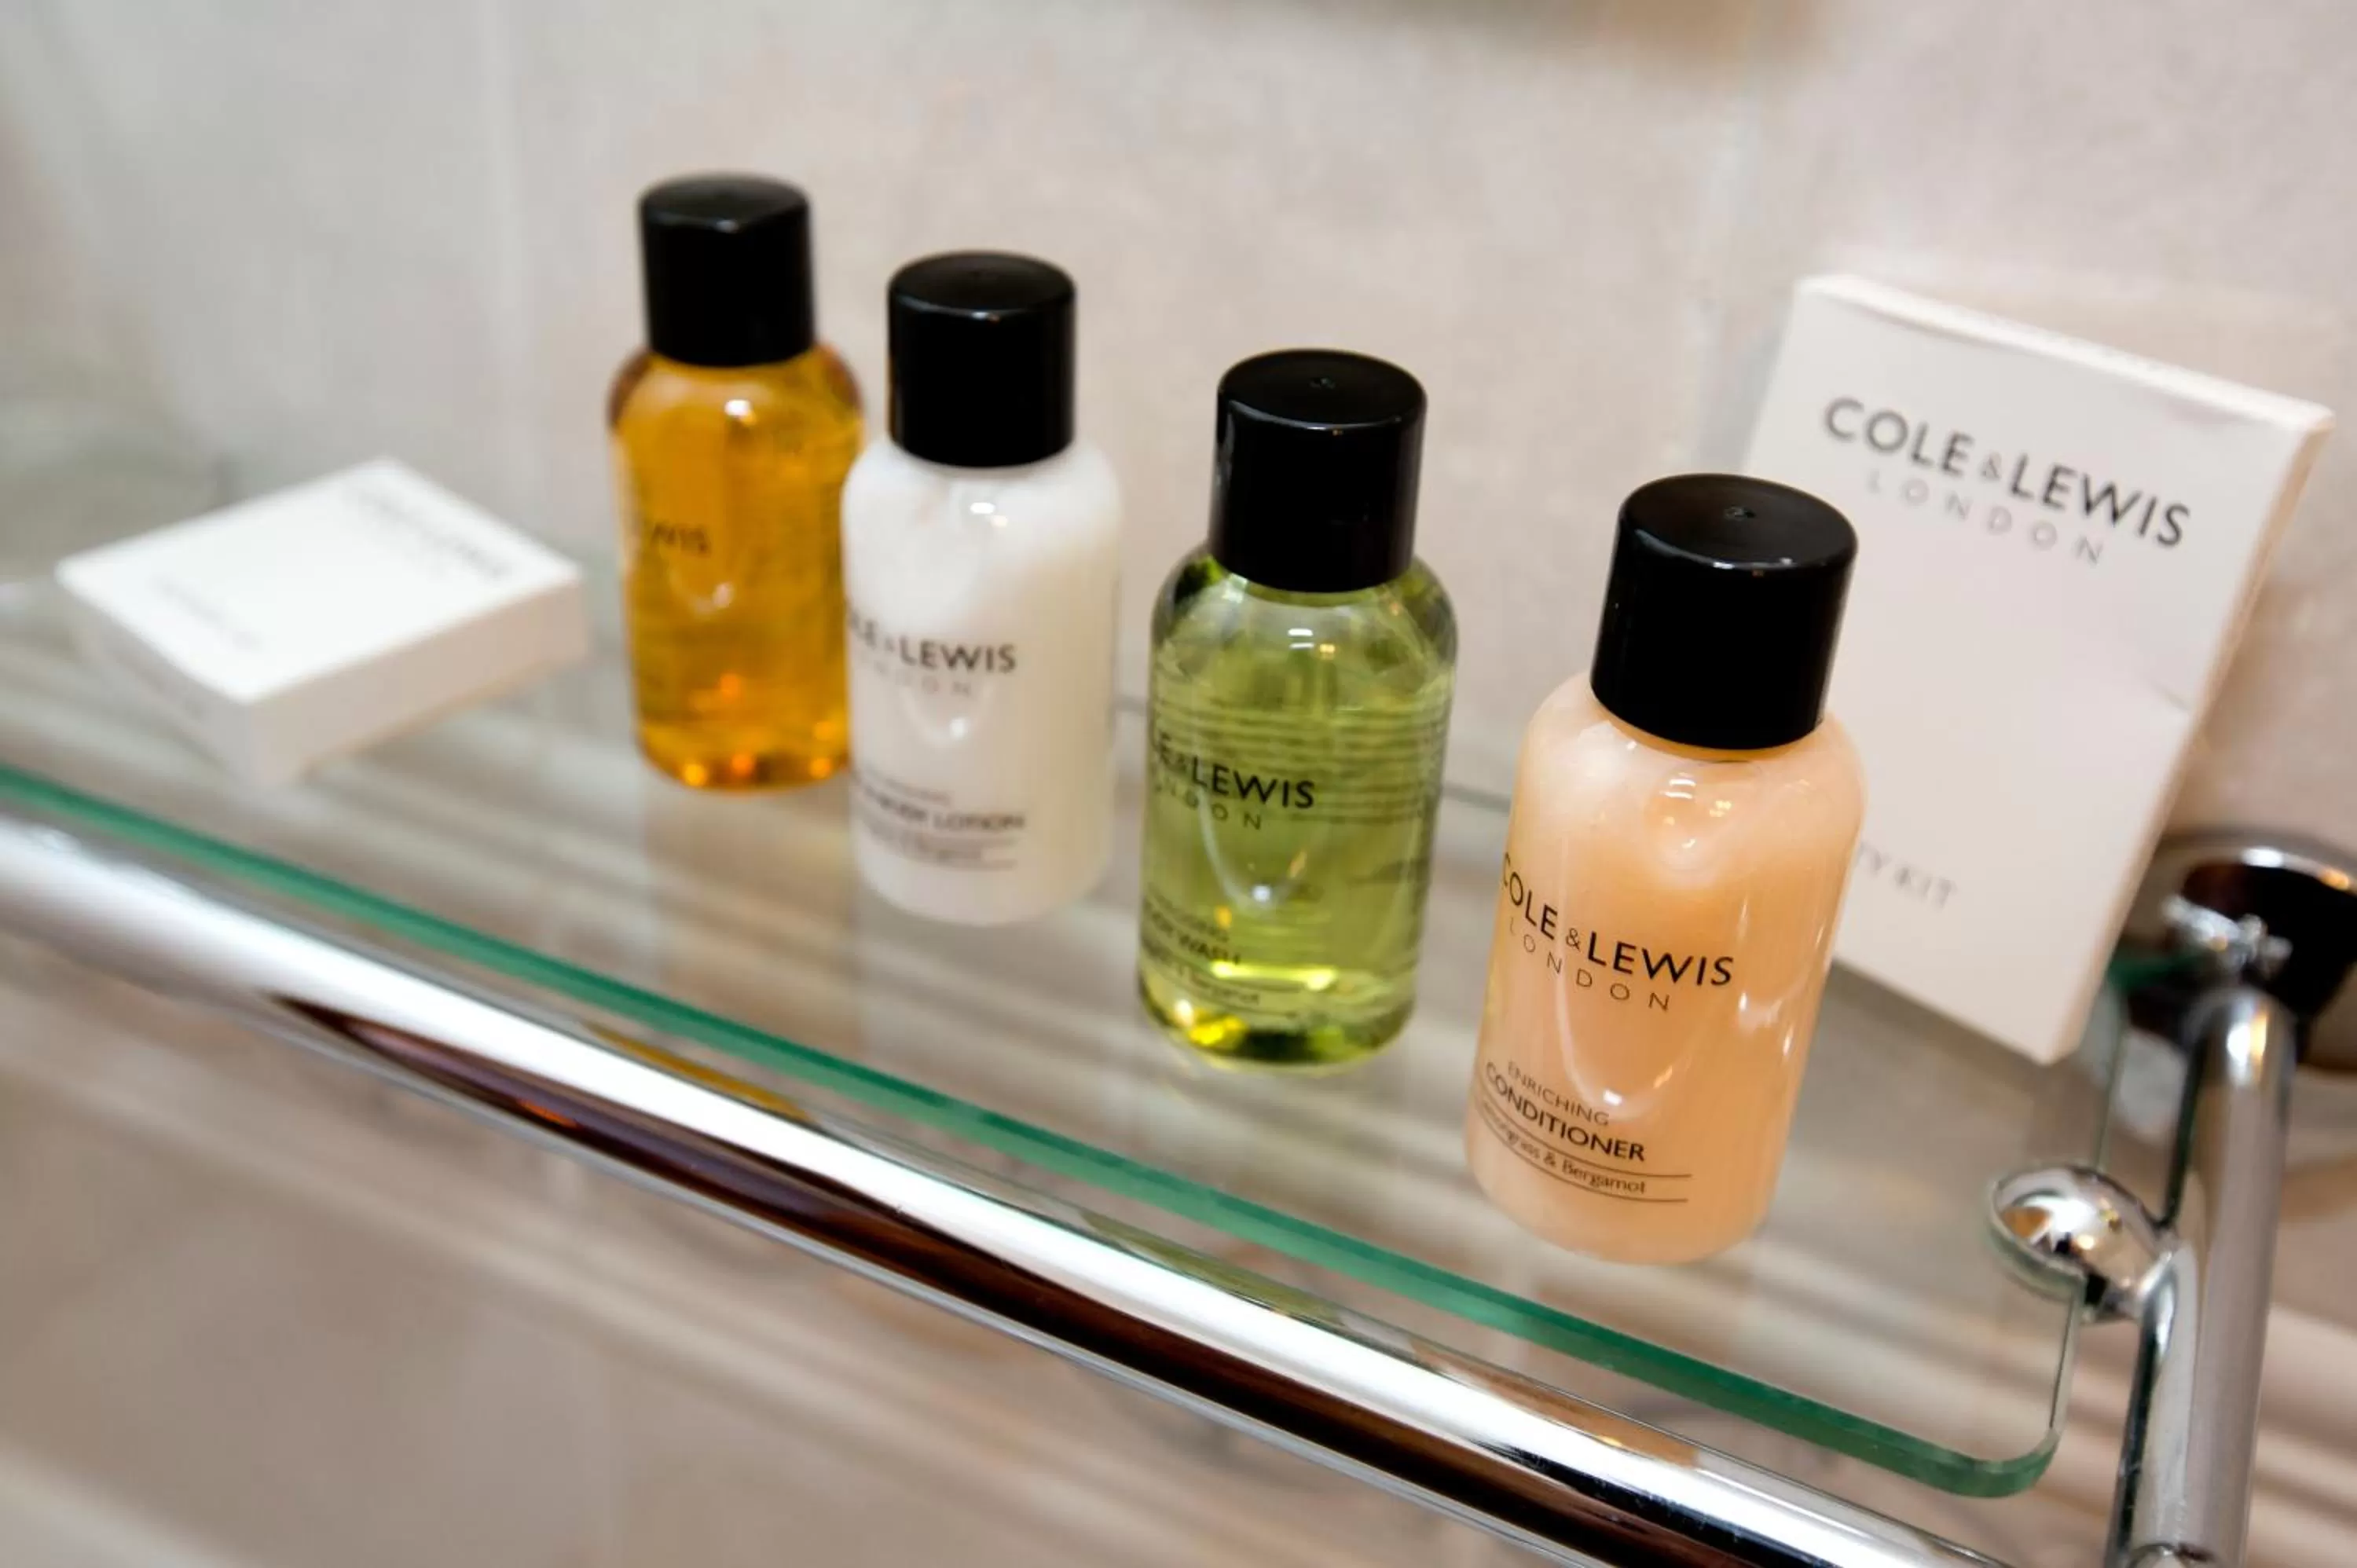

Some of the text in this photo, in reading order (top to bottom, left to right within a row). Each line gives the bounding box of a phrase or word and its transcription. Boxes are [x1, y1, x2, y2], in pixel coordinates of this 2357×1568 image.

[1865, 467, 2106, 567] LONDON
[1508, 915, 1671, 1013] LONDON
[1485, 1061, 1646, 1163] CONDITIONER
[1506, 1059, 1611, 1128] ENRICHING
[1560, 1158, 1647, 1195] Bergamot
